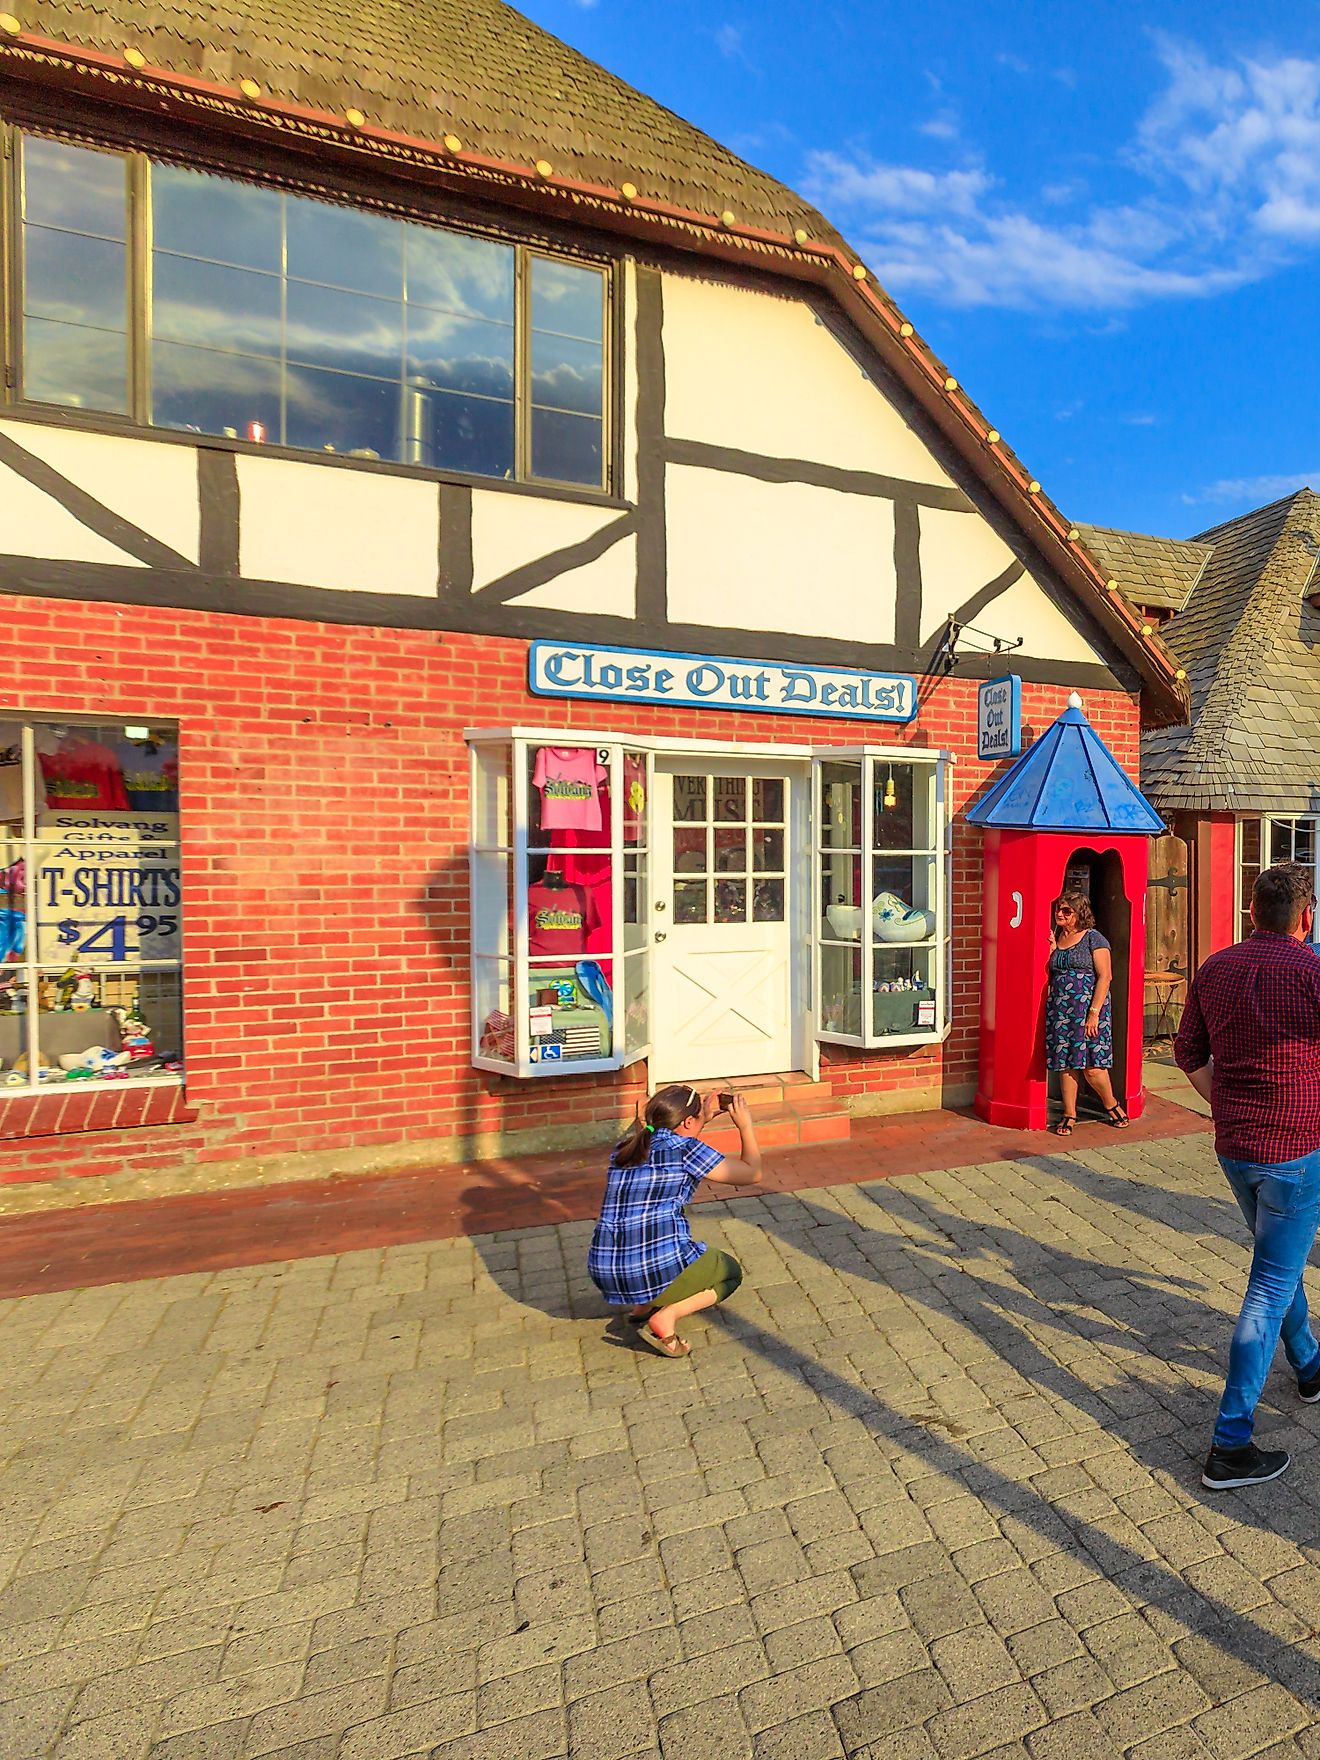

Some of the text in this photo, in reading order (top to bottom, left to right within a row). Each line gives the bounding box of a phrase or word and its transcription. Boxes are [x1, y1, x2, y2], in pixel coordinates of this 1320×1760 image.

[544, 651, 906, 713] Close Out Deals!
[984, 687, 1007, 708] Close
[986, 708, 1004, 728] Out
[981, 728, 1009, 751] Deals!
[598, 749, 610, 764] 9
[56, 817, 169, 832] Solvang
[54, 847, 169, 861] Apparel
[42, 867, 182, 908] T-SHIRTS
